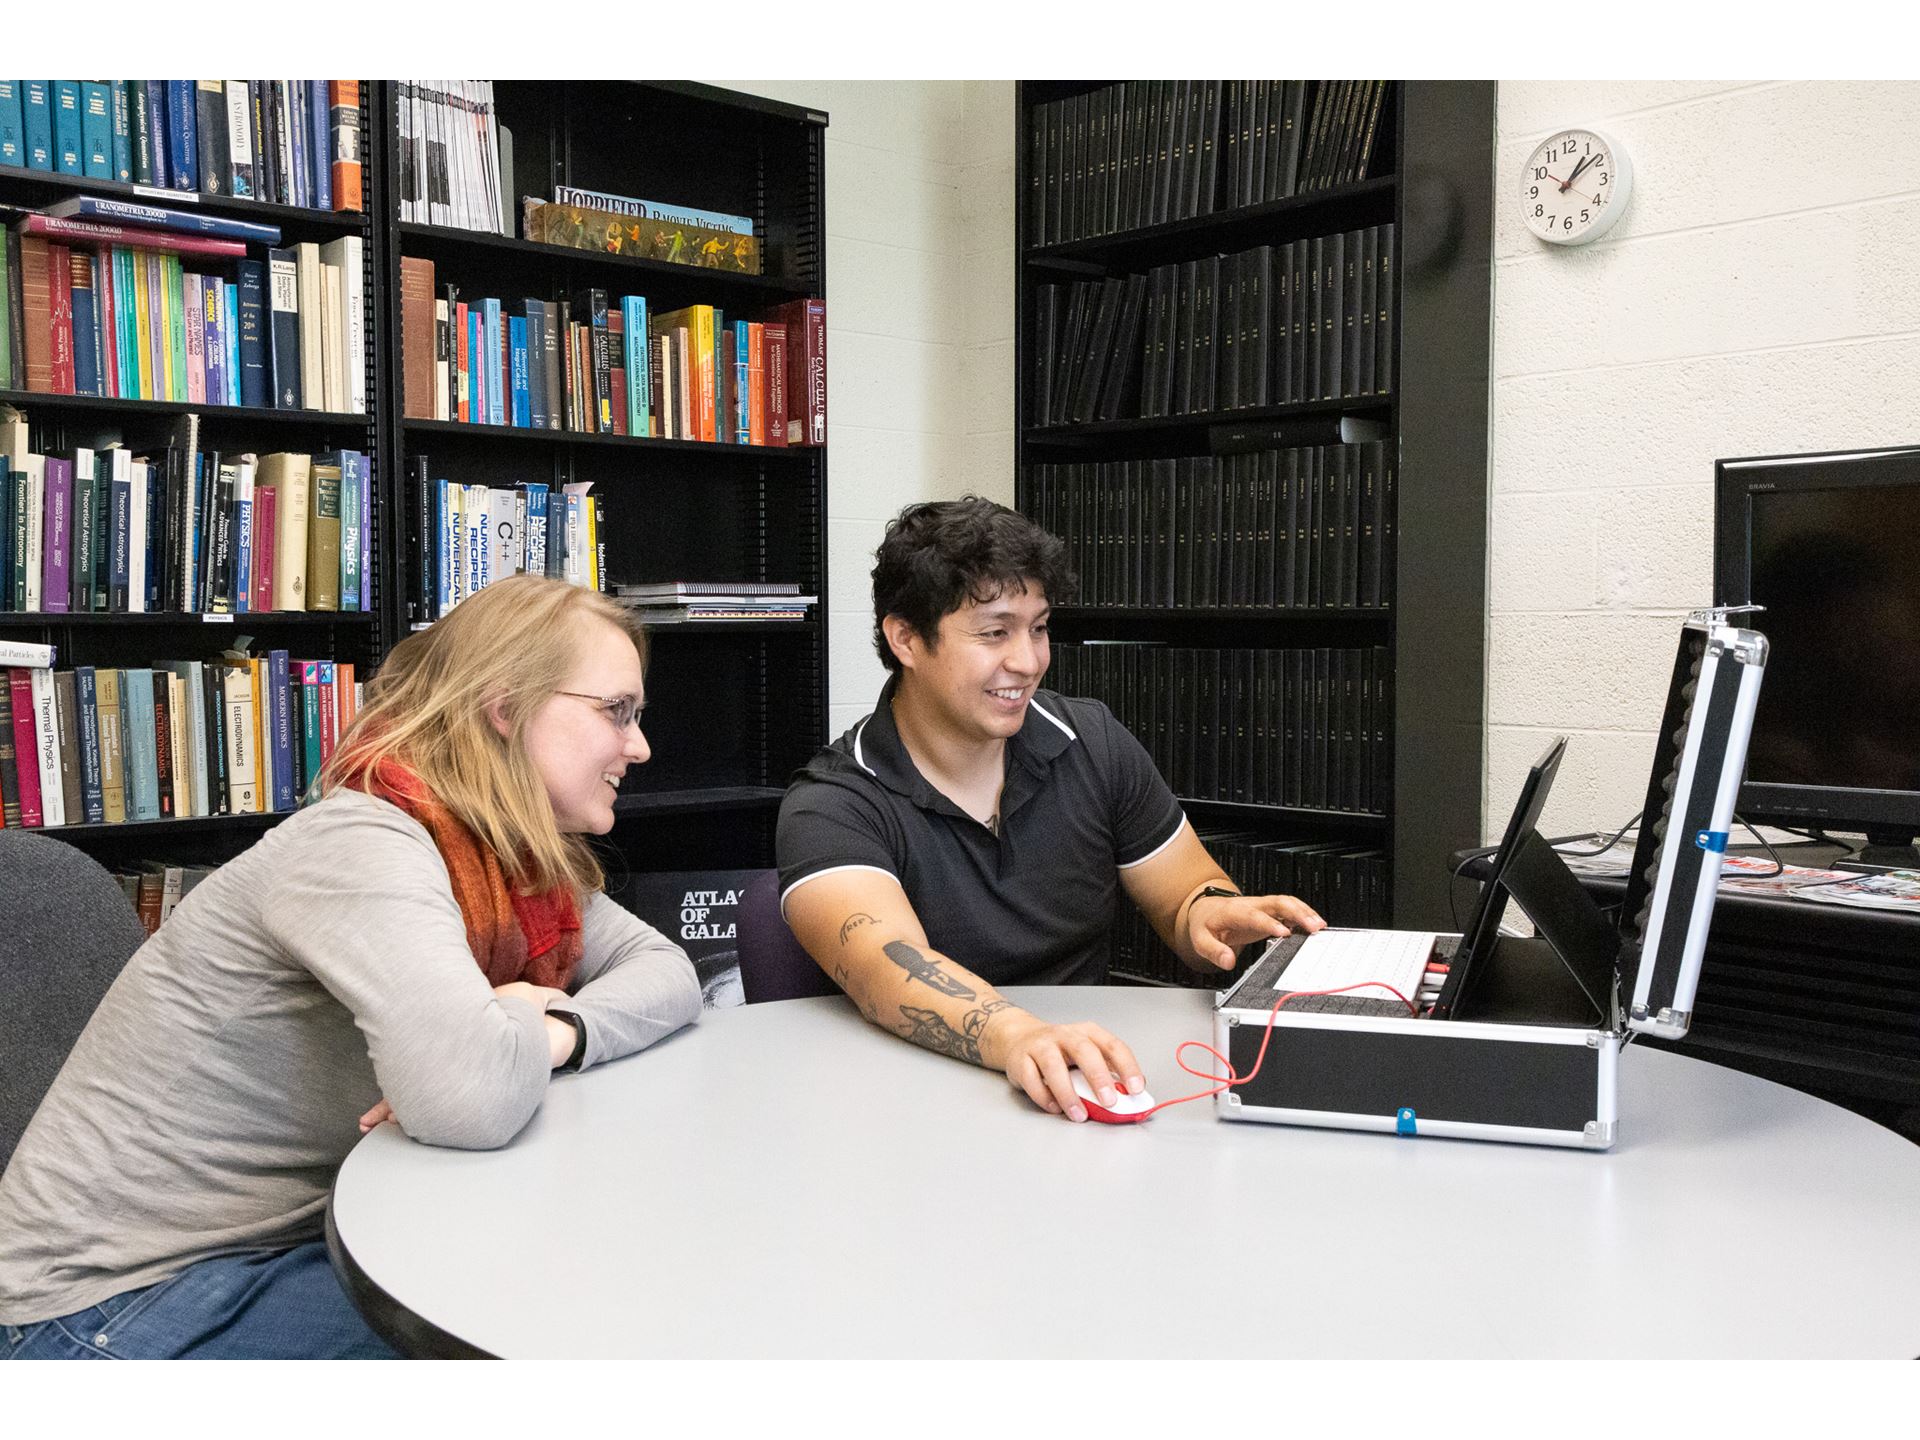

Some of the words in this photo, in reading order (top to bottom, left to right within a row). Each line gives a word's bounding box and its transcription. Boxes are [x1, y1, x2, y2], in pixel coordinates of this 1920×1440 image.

[137, 91, 148, 133] Astrophysical
[233, 101, 245, 150] ASTRONOMY
[139, 135, 149, 169] Quantities
[1546, 149, 1558, 164] 11
[1562, 139, 1577, 155] 12
[1584, 142, 1591, 155] 1
[1595, 153, 1604, 168] 2
[1534, 166, 1549, 181] 10
[1599, 172, 1608, 186] 3
[1530, 185, 1539, 200] 9
[1592, 192, 1602, 207] 4
[95, 201, 145, 216] URANOMETRIA
[1534, 203, 1544, 218] 8
[1547, 215, 1556, 229] 7
[1563, 216, 1573, 230] 6
[1580, 209, 1590, 223] 5
[45, 218, 98, 232] URANOMETRIA
[192, 307, 202, 327] STAR
[206, 288, 215, 323] SCIENCE
[193, 328, 203, 356] NAMES
[599, 335, 610, 370] CALCULUS
[814, 356, 825, 417] CALCULUS
[18, 479, 26, 514] Frontiers
[1748, 482, 1776, 490] BRAVIA
[18, 515, 26, 523] in
[82, 488, 91, 528] Theoretical
[118, 490, 127, 530] Theoretical
[217, 510, 225, 542] ADVANCED
[241, 503, 251, 548] PHYSICS
[497, 521, 514, 561] C++
[16, 525, 26, 568] Astronomy
[80, 528, 90, 573] Astrophysics
[116, 530, 126, 574] Astrophysics
[216, 542, 224, 567] PHYSICS
[344, 527, 358, 575] Physics
[452, 512, 460, 605] NUMERICAL
[470, 527, 479, 592] RECIPES
[480, 513, 488, 589] NUMERIC
[538, 516, 547, 576] NUMERI
[597, 543, 606, 568] Modern
[598, 567, 606, 592] Fortran
[8, 649, 34, 658] Particles
[277, 657, 285, 676] Krane
[40, 696, 54, 733] Thermal
[278, 685, 287, 718] MODERN
[83, 715, 91, 740] Statistical
[155, 703, 166, 779] ELECTRODYNAMICS
[216, 725, 222, 733] TO
[233, 705, 244, 767] ELECTRODYNAMICS
[280, 718, 288, 749] PHYSICS
[44, 734, 57, 770] Physics
[85, 740, 93, 784] Thermodynamics
[217, 733, 225, 778] ELECTRODYNAMICS
[680, 907, 710, 924] OF
[680, 923, 737, 940] GALA
